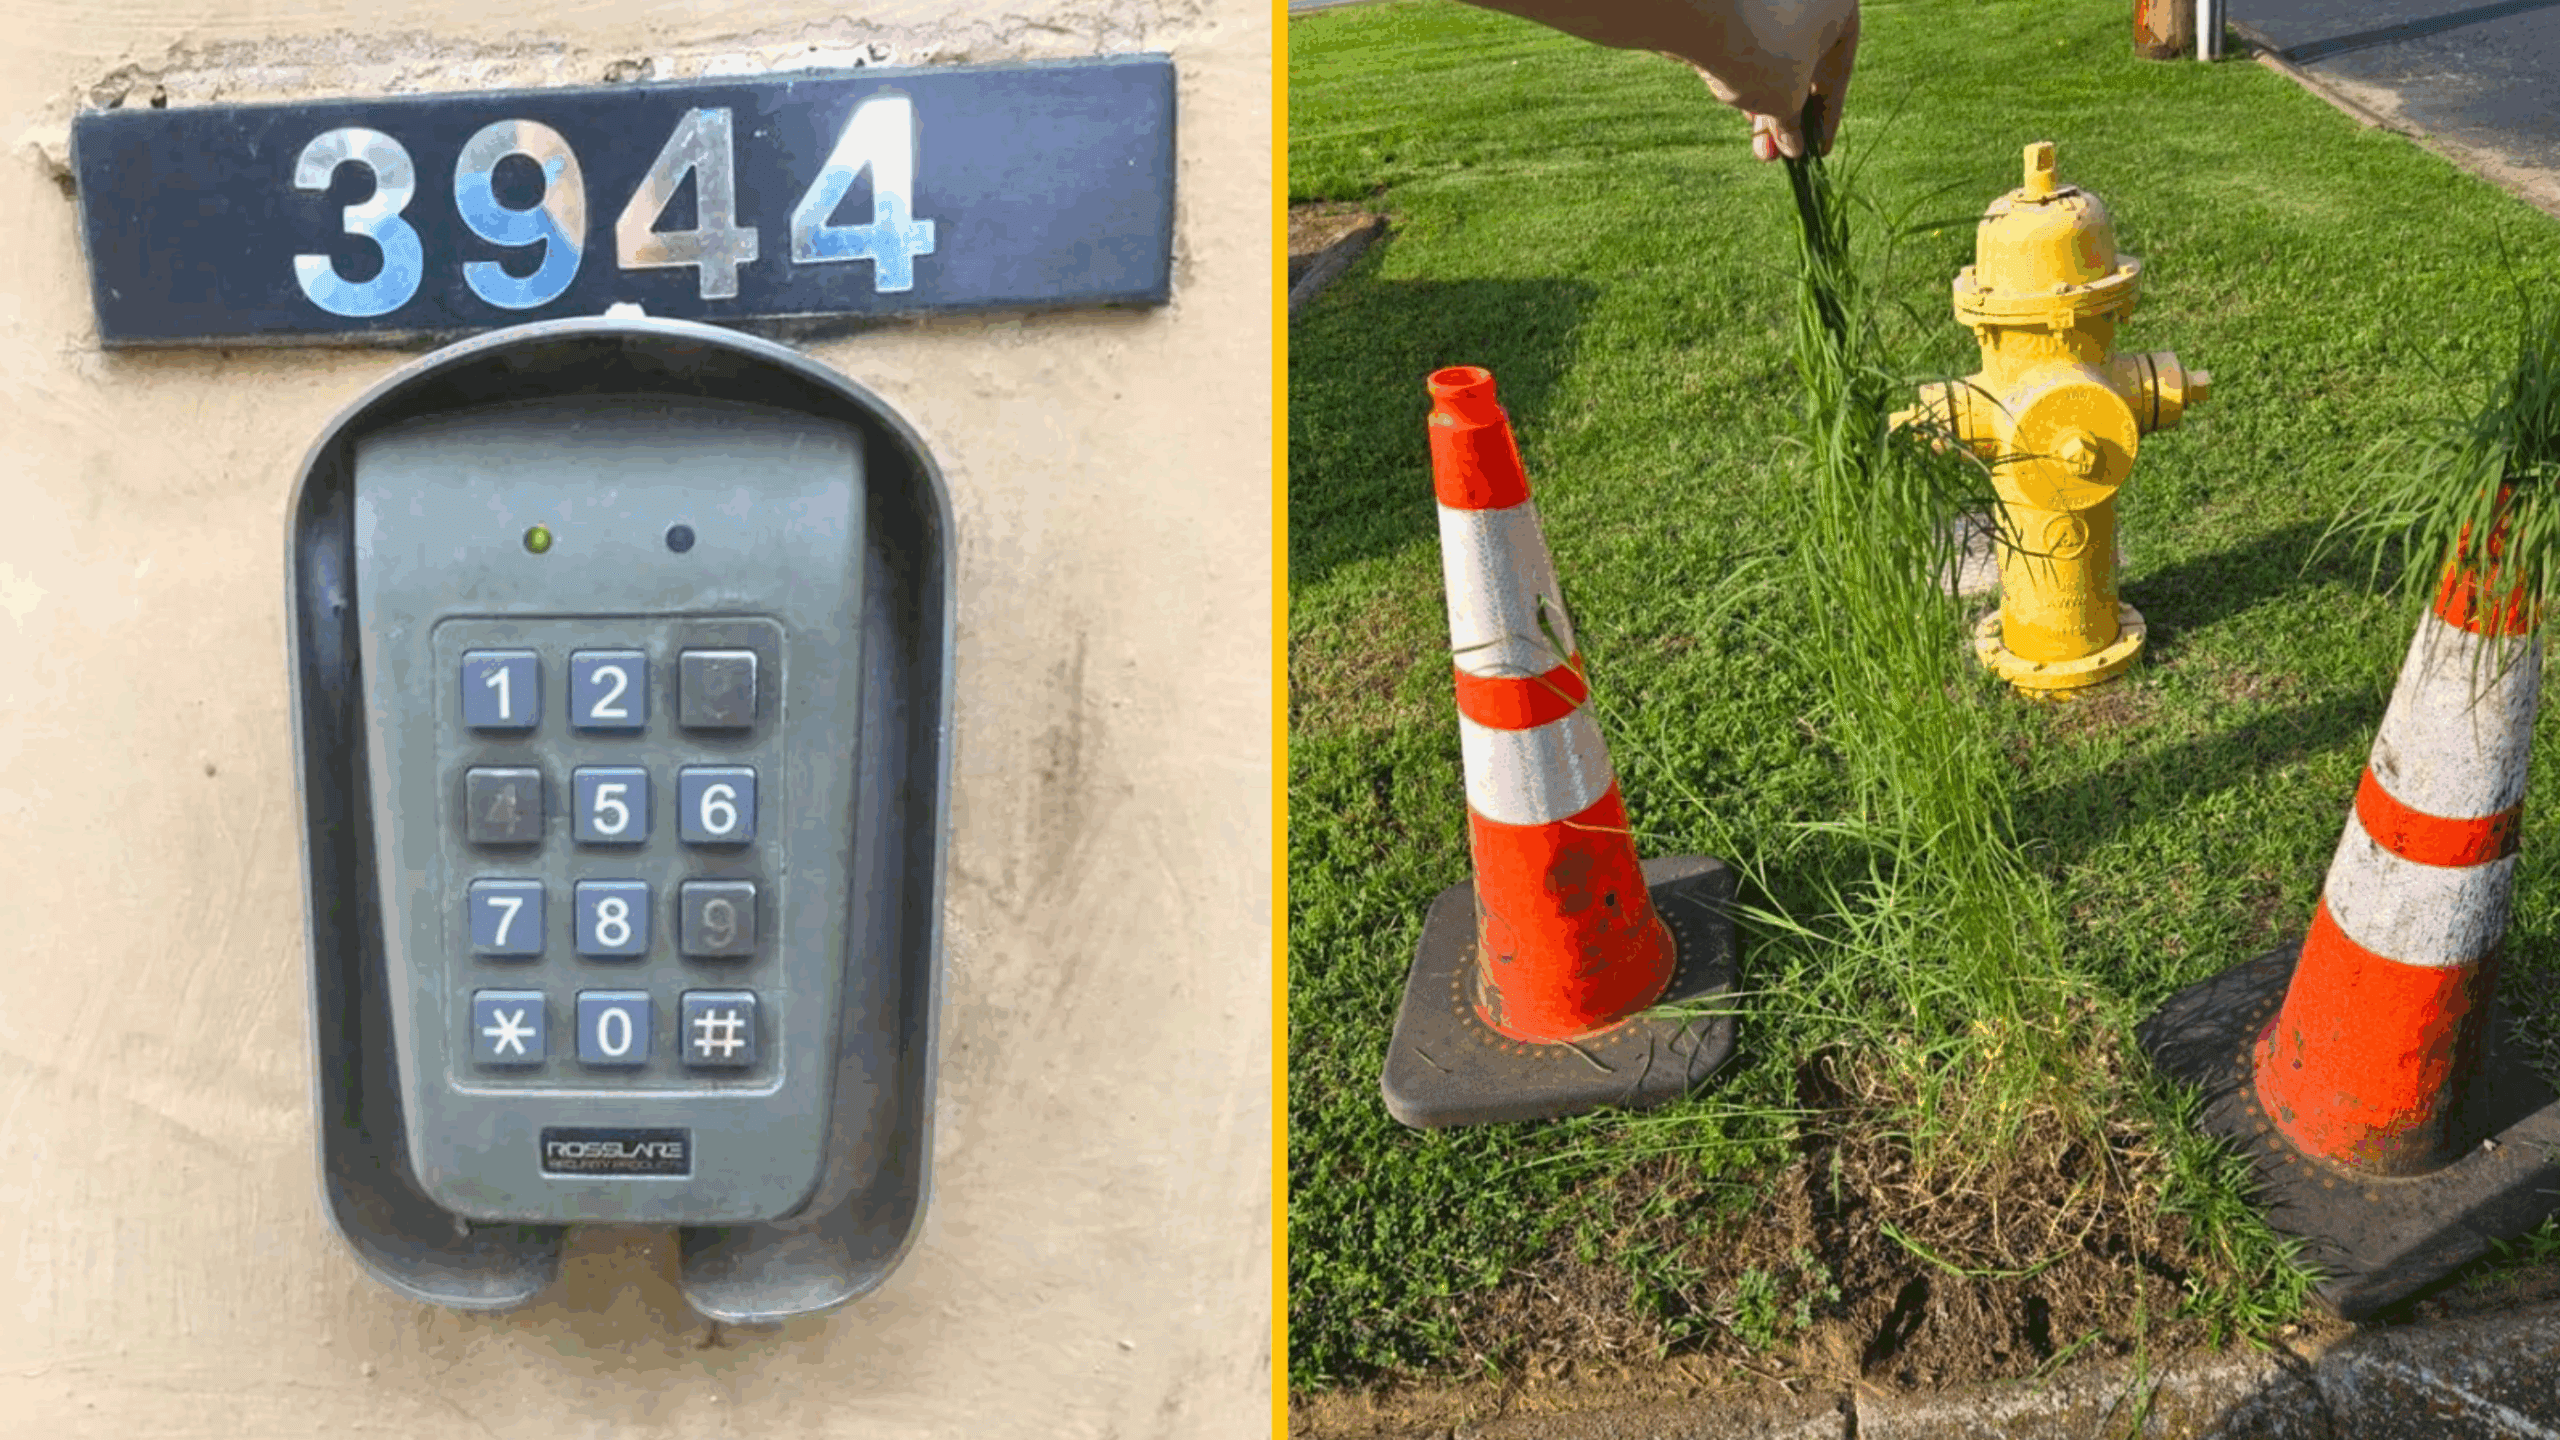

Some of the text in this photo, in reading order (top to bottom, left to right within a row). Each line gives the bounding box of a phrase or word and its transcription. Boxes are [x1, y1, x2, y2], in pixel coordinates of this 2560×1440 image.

[293, 95, 936, 317] 3944
[485, 665, 628, 718] 1 2
[592, 783, 631, 835] 5
[700, 783, 737, 835] 6
[487, 897, 737, 948] 7 8 9
[598, 1007, 633, 1056] 0
[693, 1008, 745, 1057] #
[547, 1141, 683, 1159] ROSSLARE
